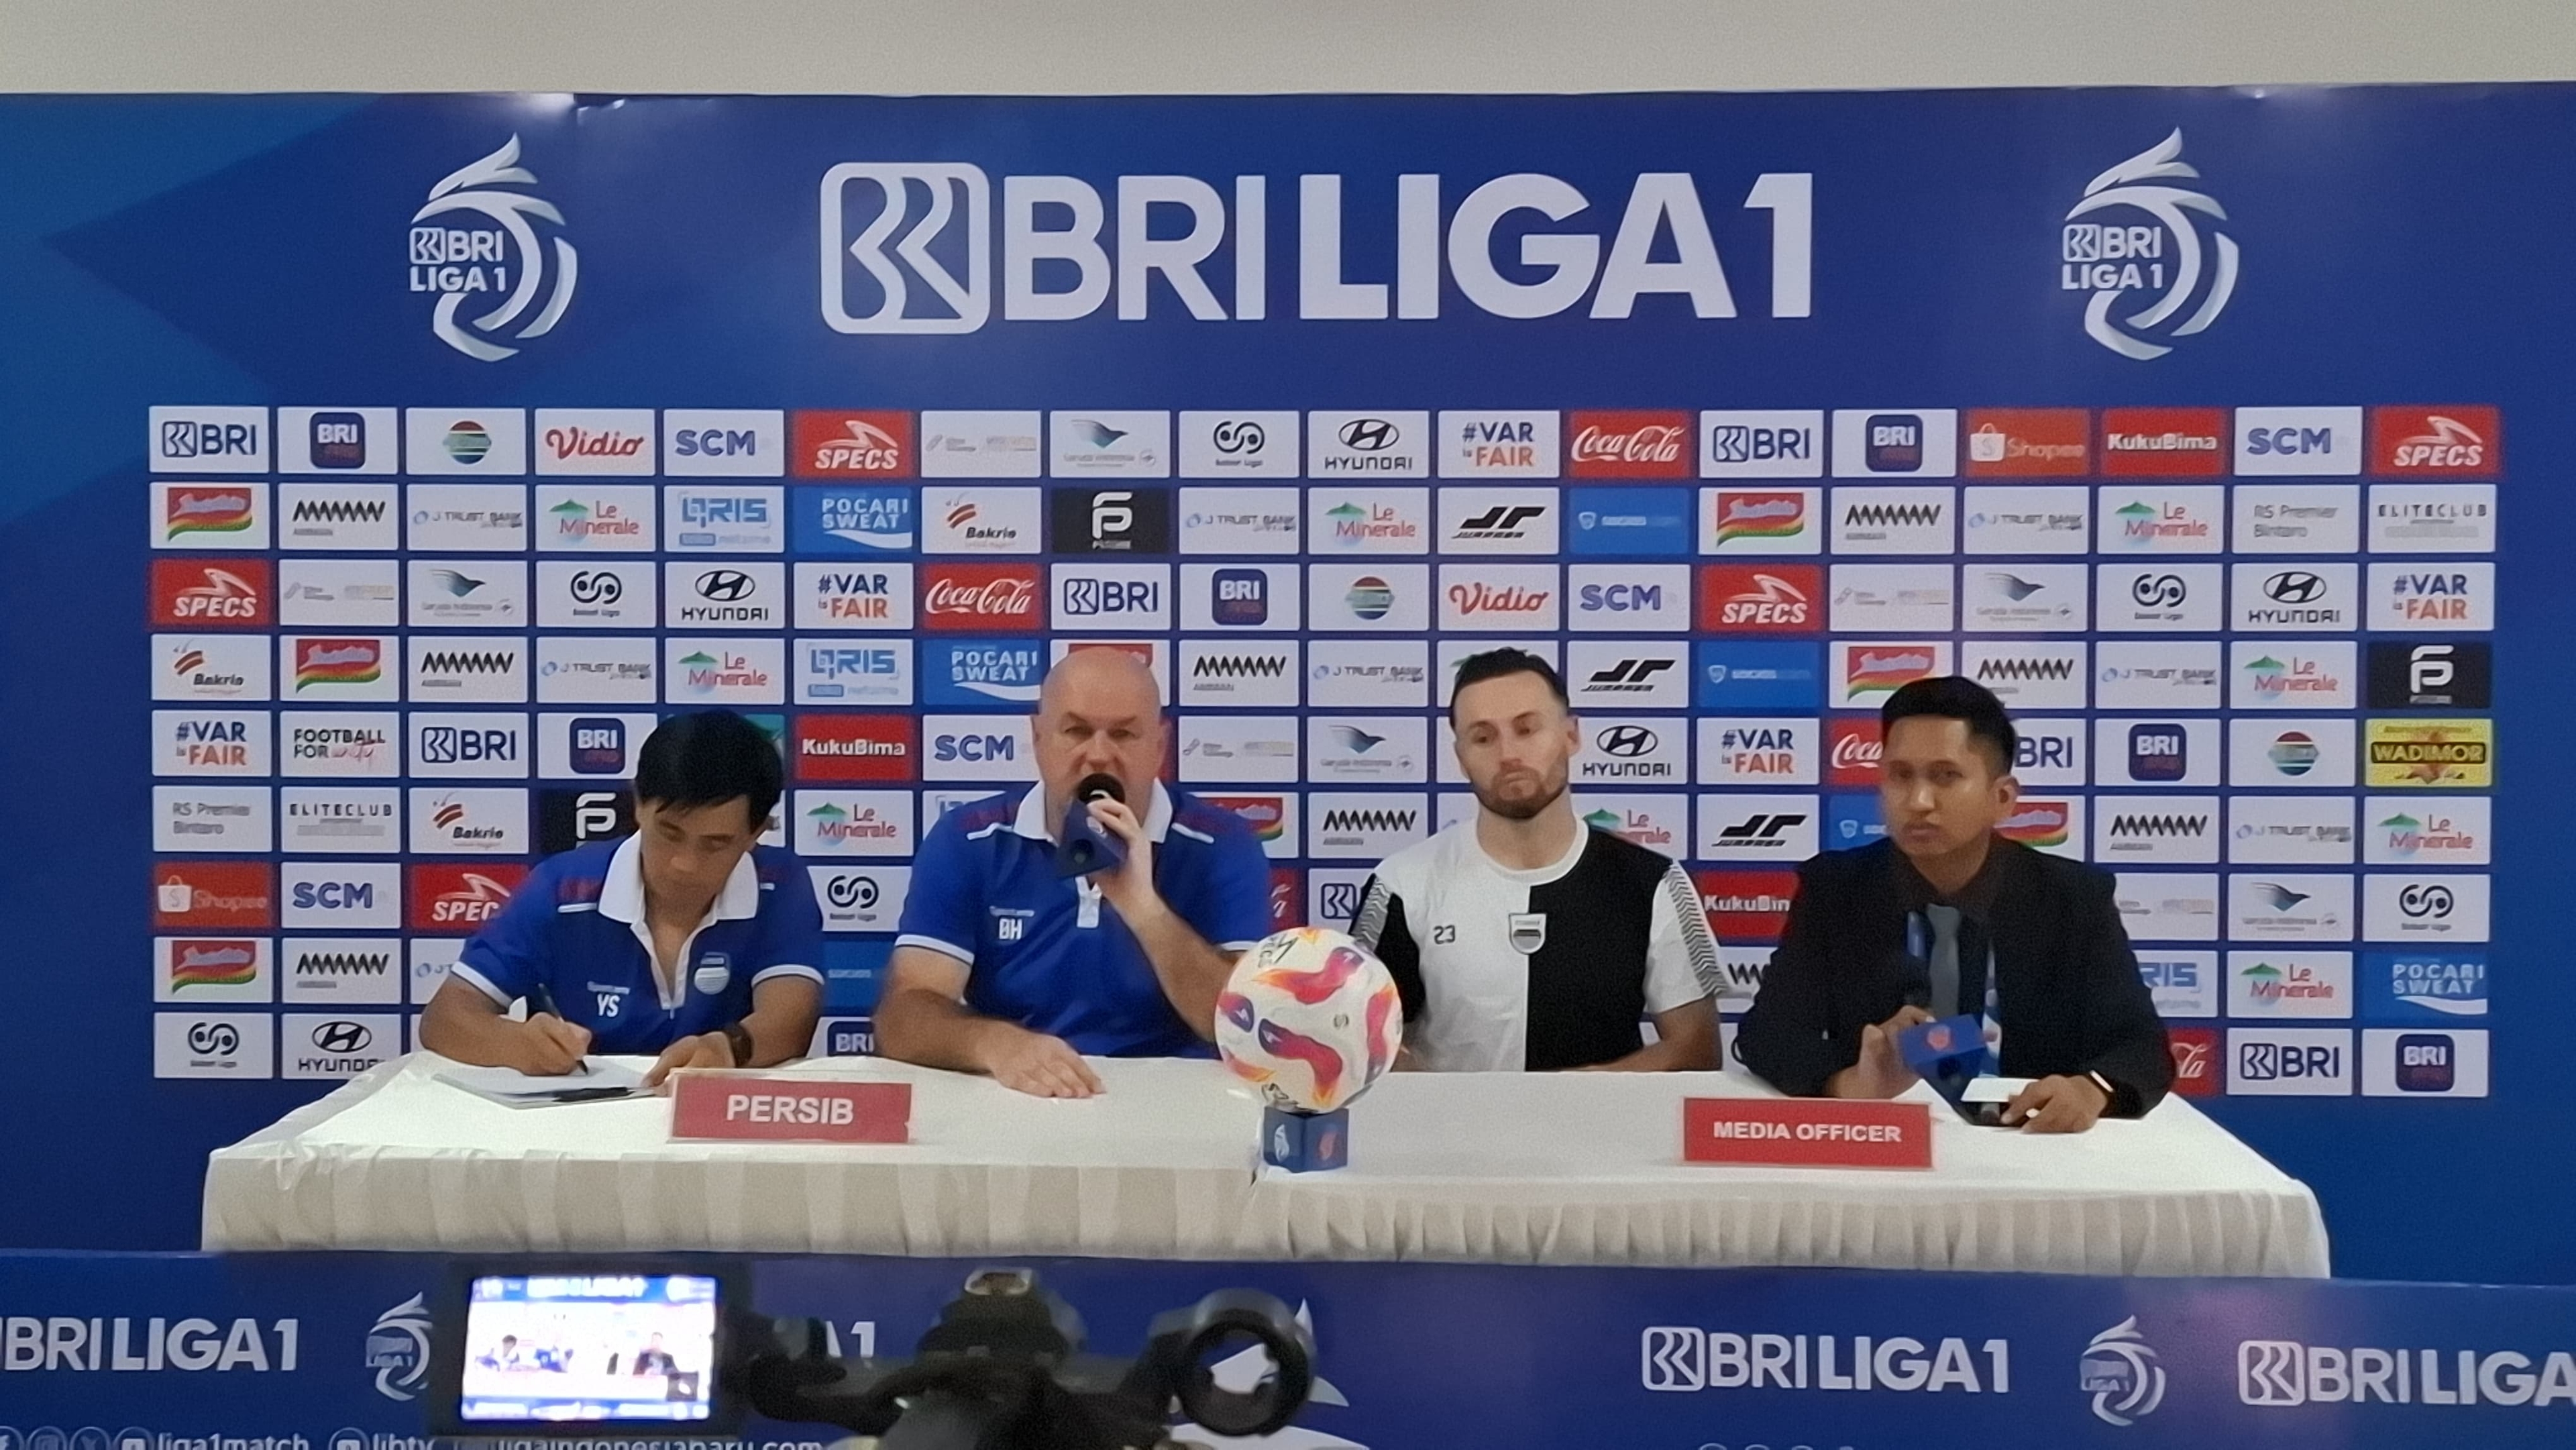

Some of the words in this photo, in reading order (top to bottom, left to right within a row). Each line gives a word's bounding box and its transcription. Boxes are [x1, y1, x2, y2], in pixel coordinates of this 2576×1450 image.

[448, 230, 503, 262] BRI
[1004, 176, 1265, 320] BRI
[1299, 172, 1737, 320] LIGA
[1744, 172, 1813, 317] 1
[2102, 227, 2161, 258] BRI
[410, 266, 487, 291] LIGA
[494, 268, 506, 291] 1
[2062, 264, 2143, 290] LIGA
[2150, 264, 2162, 289] 1
[202, 425, 256, 454] BRI
[317, 424, 358, 443] BRI
[1462, 422, 1534, 443] #VAR
[1874, 427, 1915, 446] BRI
[2108, 433, 2217, 450] KukuBima
[2247, 429, 2330, 454] SCM
[545, 427, 644, 459] Vidio
[676, 430, 755, 456] SCM
[1754, 429, 1809, 459] BRI
[815, 447, 899, 470] SPECS
[1325, 457, 1411, 470] HYUNDAI
[1476, 446, 1534, 466] FAIR
[2394, 444, 2482, 466] SPECS
[595, 501, 616, 519] Le
[822, 498, 908, 513] POCARI
[1373, 503, 1394, 521] Le
[2163, 503, 2185, 519] Le
[559, 517, 639, 535] Minerale
[822, 513, 899, 529] SWEAT
[1336, 521, 1415, 537] Minerale
[2125, 519, 2208, 536] Minerale
[818, 574, 888, 594] #VAR
[1220, 580, 1260, 600] BRI
[2393, 574, 2466, 595] #VAR
[174, 597, 256, 617] SPECS
[1102, 582, 1157, 613] BRI
[1449, 583, 1549, 615] Vidio
[1580, 584, 1660, 611] SCM
[682, 607, 768, 621] HYUNDAI
[831, 599, 888, 618] FAIR
[1721, 602, 1807, 623] SPECS
[2249, 609, 2340, 623] HYUNDAI
[2406, 600, 2467, 619] FAIR
[724, 652, 745, 670] Le
[952, 652, 1037, 666] POCARI
[2294, 658, 2314, 674] Le
[688, 669, 767, 686] Minerale
[952, 666, 1029, 681] SWEAT
[2255, 674, 2337, 691] Minerale
[176, 721, 246, 742] #VAR
[294, 729, 385, 743] FOOTBALL
[578, 729, 616, 749] BRI
[1721, 729, 1793, 749] #VAR
[190, 745, 246, 765] FAIR
[294, 745, 329, 758] FOR
[460, 731, 516, 760] BRI
[802, 739, 905, 757] KukuBima
[935, 735, 1014, 761] SCM
[2017, 736, 2072, 768] BRI
[2137, 735, 2179, 756] BRI
[2374, 745, 2484, 762] WADIMOR
[1583, 762, 1670, 776] HYUNDAI
[1735, 754, 1794, 774] FAIR
[290, 805, 391, 816] ELITECLUB
[853, 803, 874, 821] Le
[1627, 809, 1649, 827] Le
[818, 821, 896, 838] Minerale
[2428, 815, 2449, 832] Le
[2389, 832, 2473, 849] Minerale
[292, 882, 372, 909] SCM
[433, 900, 498, 921] SPEC
[1434, 925, 1455, 944] 23
[2289, 963, 2311, 980] Le
[2393, 964, 2483, 979] POCARI
[2251, 980, 2334, 998] Minerale
[2393, 979, 2474, 994] SWEAT
[597, 994, 620, 1017] YS
[2282, 1047, 2339, 1077] BRI
[2403, 1046, 2446, 1066] BRI
[727, 1095, 853, 1125] PERSIB
[1714, 1121, 1790, 1141] MEDIA
[1796, 1125, 1901, 1142] OFFICER
[5, 1318, 103, 1370] BRI
[111, 1318, 269, 1371] LIGA
[273, 1318, 299, 1370] 1
[851, 1321, 875, 1357] 1
[1709, 1333, 1807, 1389] BRI
[1819, 1335, 1981, 1393] LIGA
[1983, 1339, 2008, 1393] 1
[2308, 1346, 2410, 1403] BRI
[2421, 1349, 2576, 1406] LIGA
